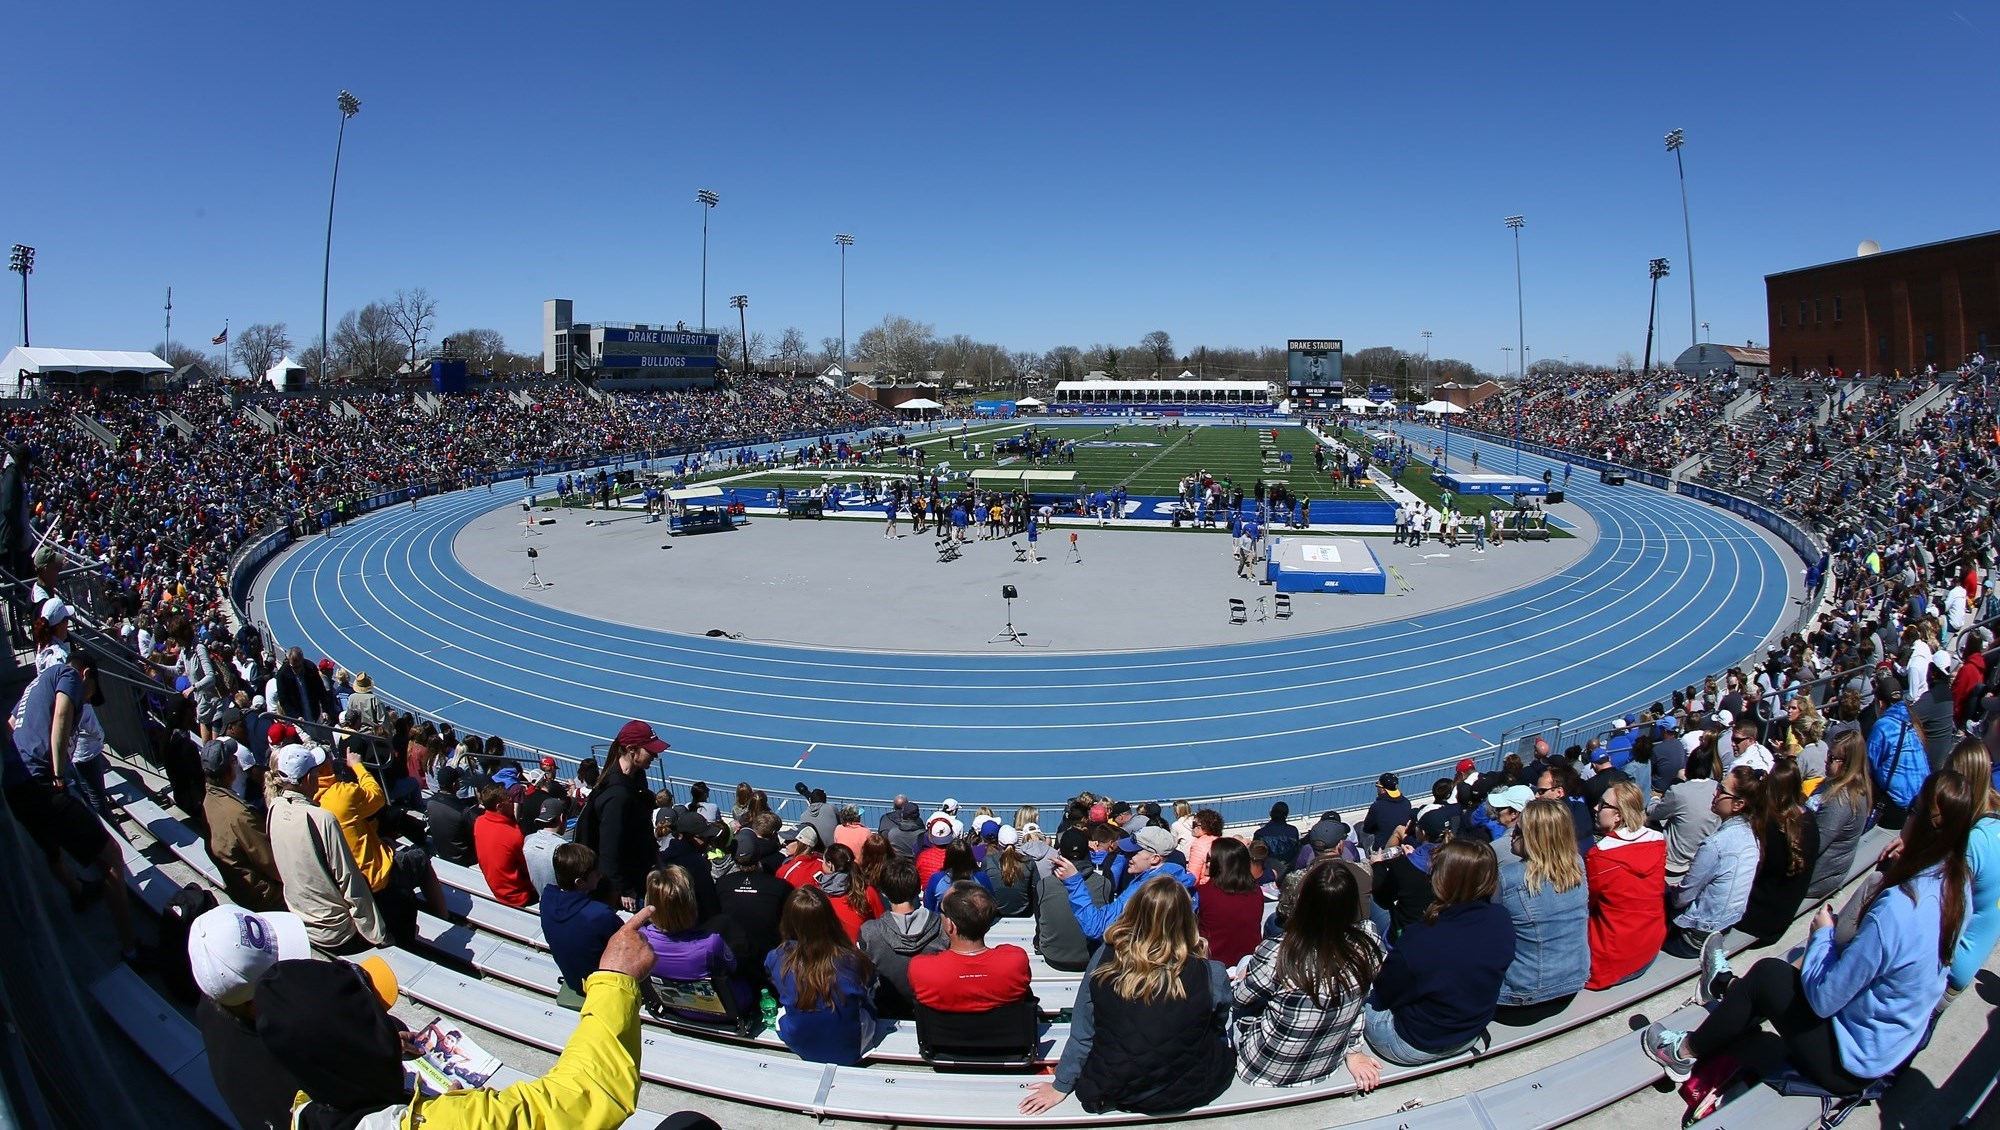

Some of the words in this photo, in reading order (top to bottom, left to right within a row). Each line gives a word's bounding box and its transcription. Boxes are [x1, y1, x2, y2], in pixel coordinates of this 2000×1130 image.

[628, 331, 657, 343] DRAKE
[661, 333, 708, 345] UNIVERSITY
[1290, 341, 1311, 350] DRAKE
[1312, 341, 1341, 350] STADIUM
[641, 356, 686, 367] BULLDOGS
[1532, 1082, 1543, 1090] 16
